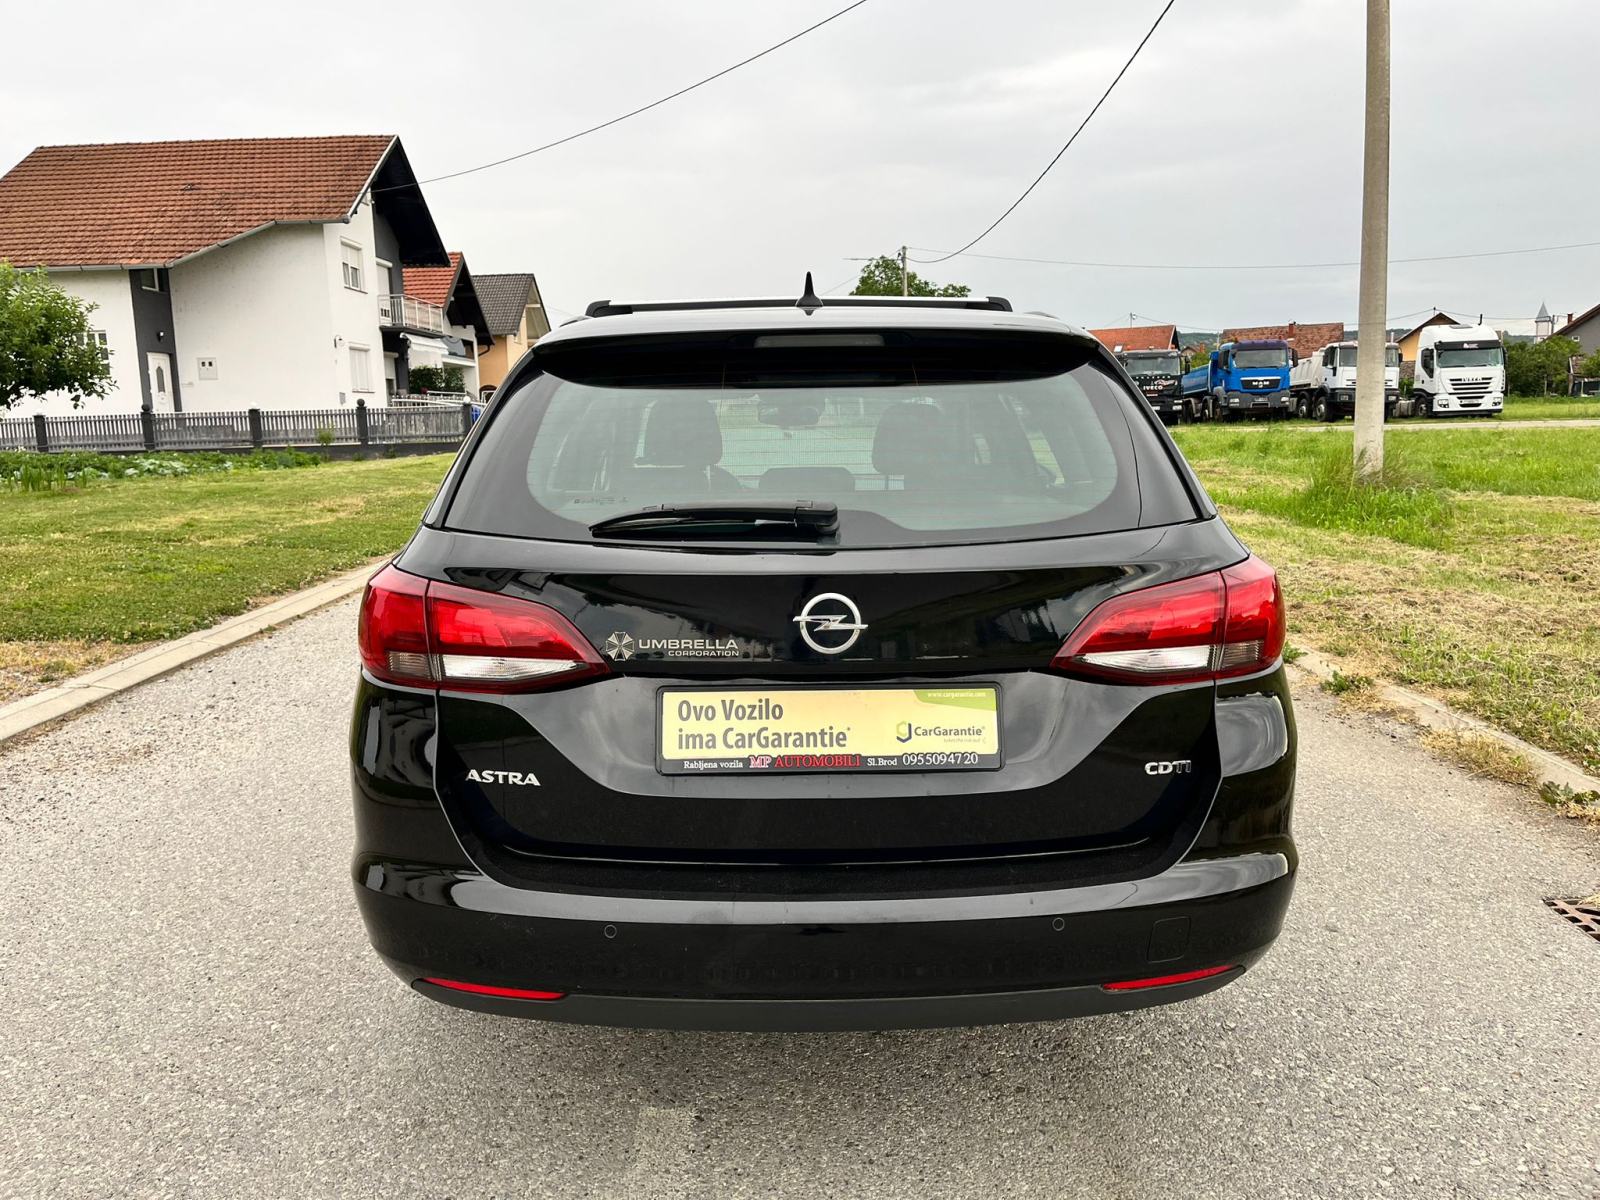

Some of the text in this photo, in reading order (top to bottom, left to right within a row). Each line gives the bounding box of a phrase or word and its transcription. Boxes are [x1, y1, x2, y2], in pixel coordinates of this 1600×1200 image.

[638, 638, 739, 650] UMBRELLA
[668, 650, 740, 658] CORPORATION
[678, 698, 784, 722] Ovo Vozilo
[678, 728, 717, 750] ima
[683, 760, 718, 771] Rabljena
[719, 760, 743, 769] vozila
[749, 755, 772, 769] MP
[774, 754, 861, 768] AUTOMOBILI
[902, 753, 979, 766] 0955094720
[1144, 759, 1192, 775] CDTI
[465, 769, 542, 787] ASTRA
